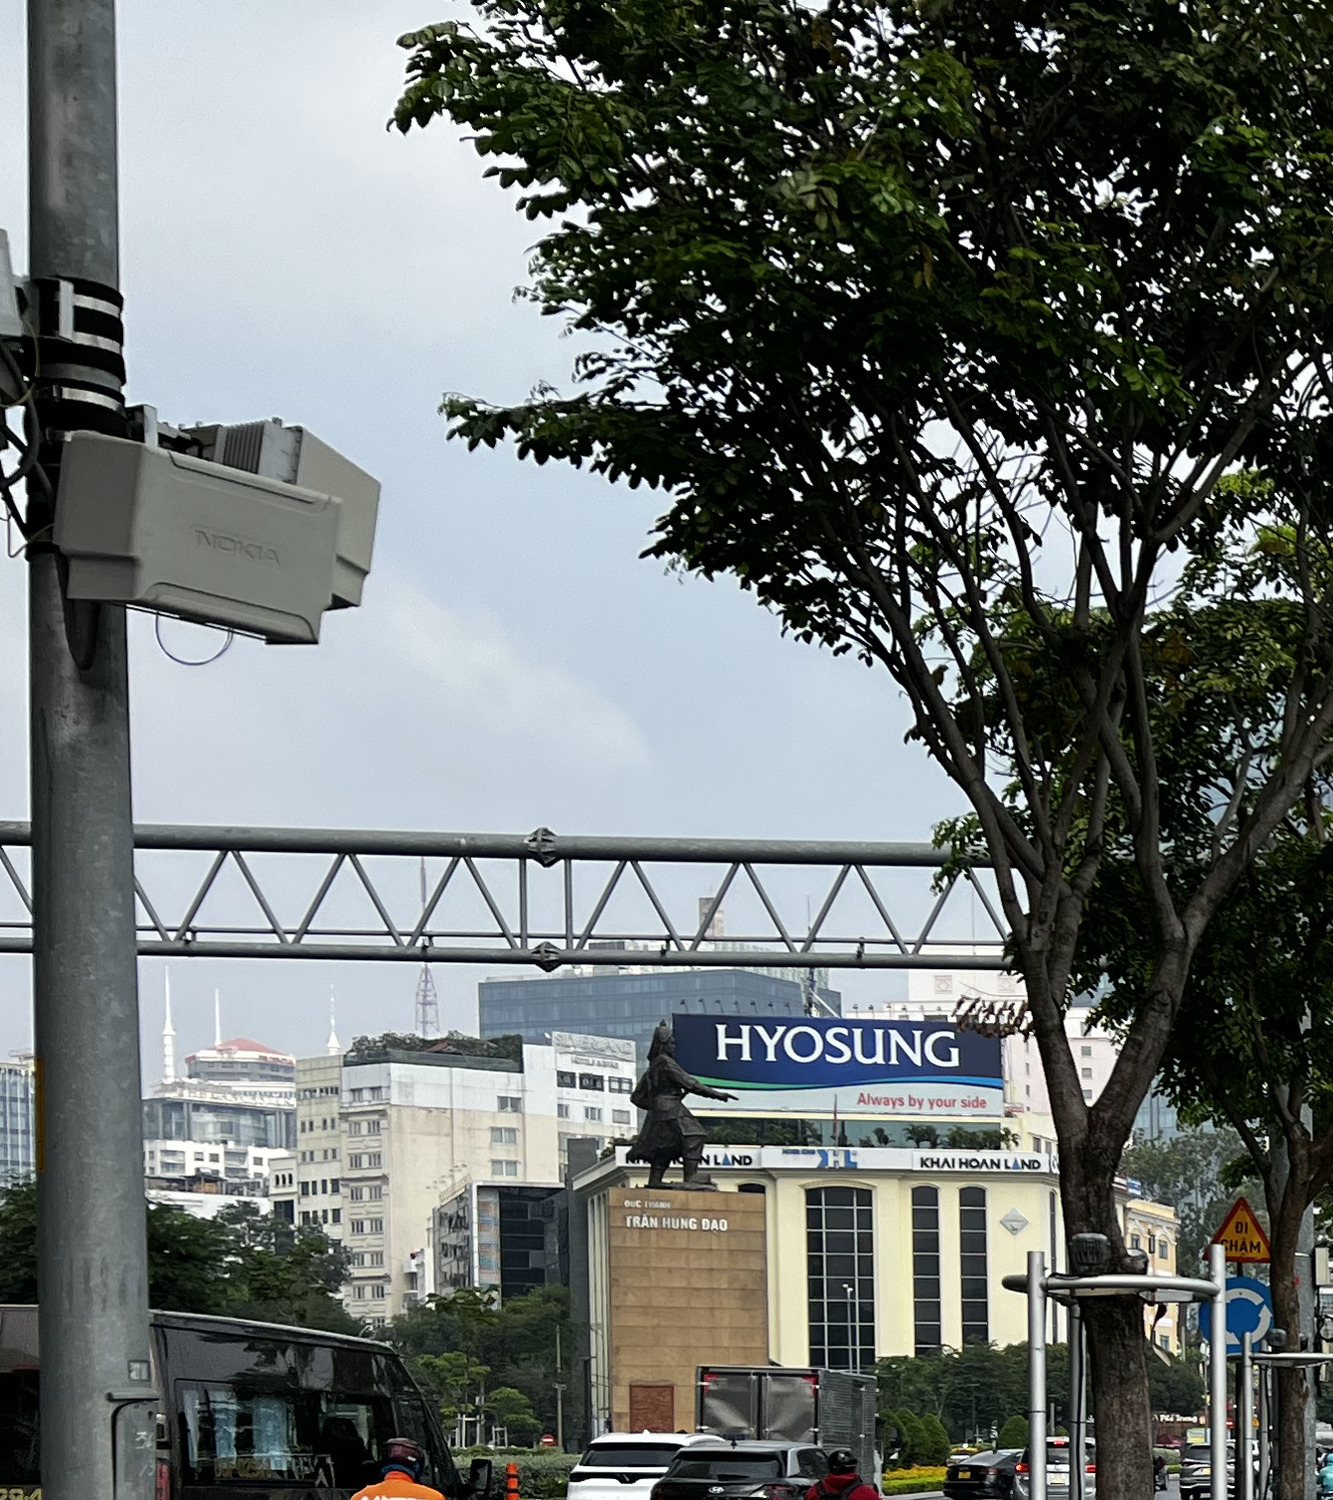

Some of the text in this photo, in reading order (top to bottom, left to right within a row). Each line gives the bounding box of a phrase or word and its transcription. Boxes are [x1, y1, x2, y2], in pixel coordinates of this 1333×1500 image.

[194, 529, 281, 567] NOKIA
[715, 1023, 960, 1068] HYOSUNG
[856, 1092, 987, 1110] Always by your side
[714, 1153, 752, 1166] LAND
[920, 1157, 1041, 1170] KHAI HOAN LAND
[1235, 1221, 1249, 1234] ĐI
